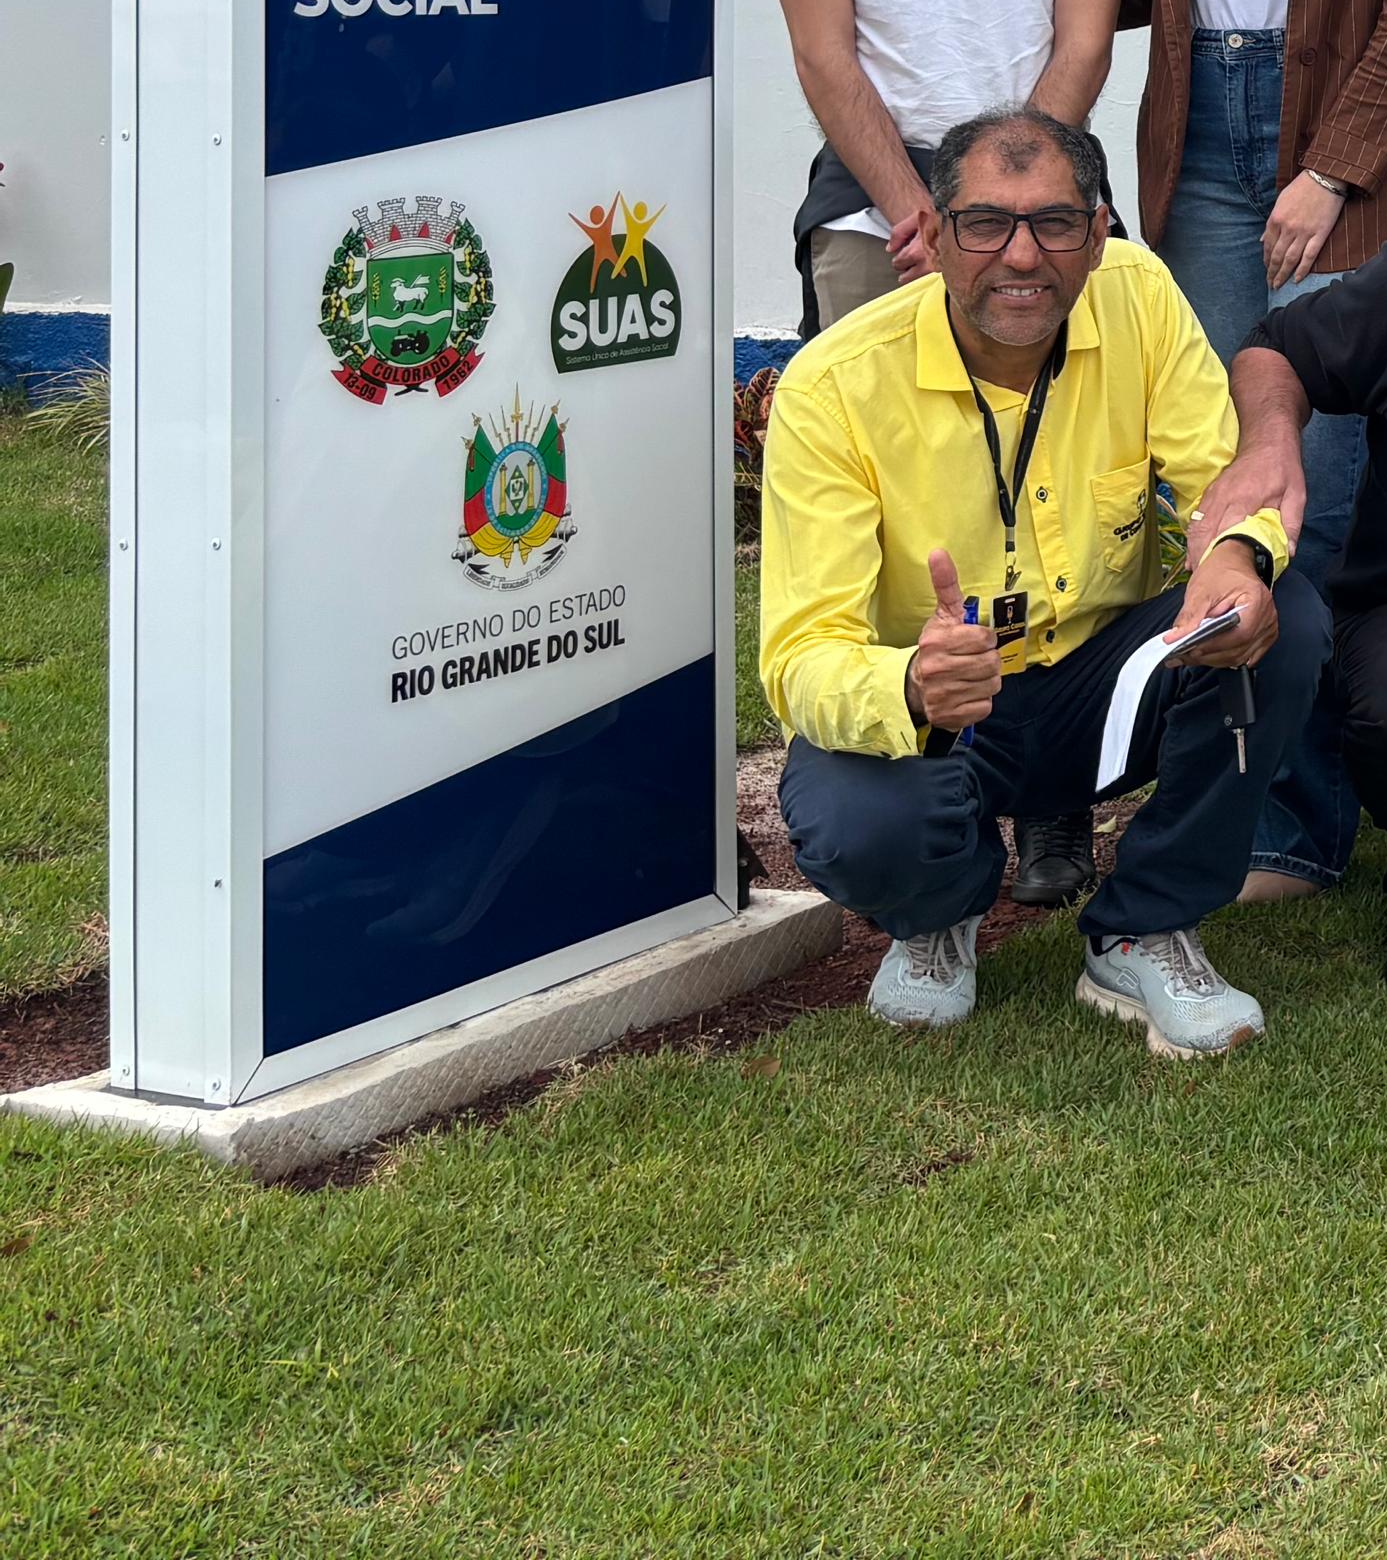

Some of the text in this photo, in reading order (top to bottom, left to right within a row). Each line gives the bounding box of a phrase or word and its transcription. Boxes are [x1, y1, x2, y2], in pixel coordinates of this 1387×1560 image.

[558, 289, 676, 351] SUAS
[343, 356, 473, 401] 13-09 COLORADO 1962
[392, 584, 626, 660] GOVERNO DO ESTADO
[391, 618, 626, 704] RIO GRANDE DO SUL
